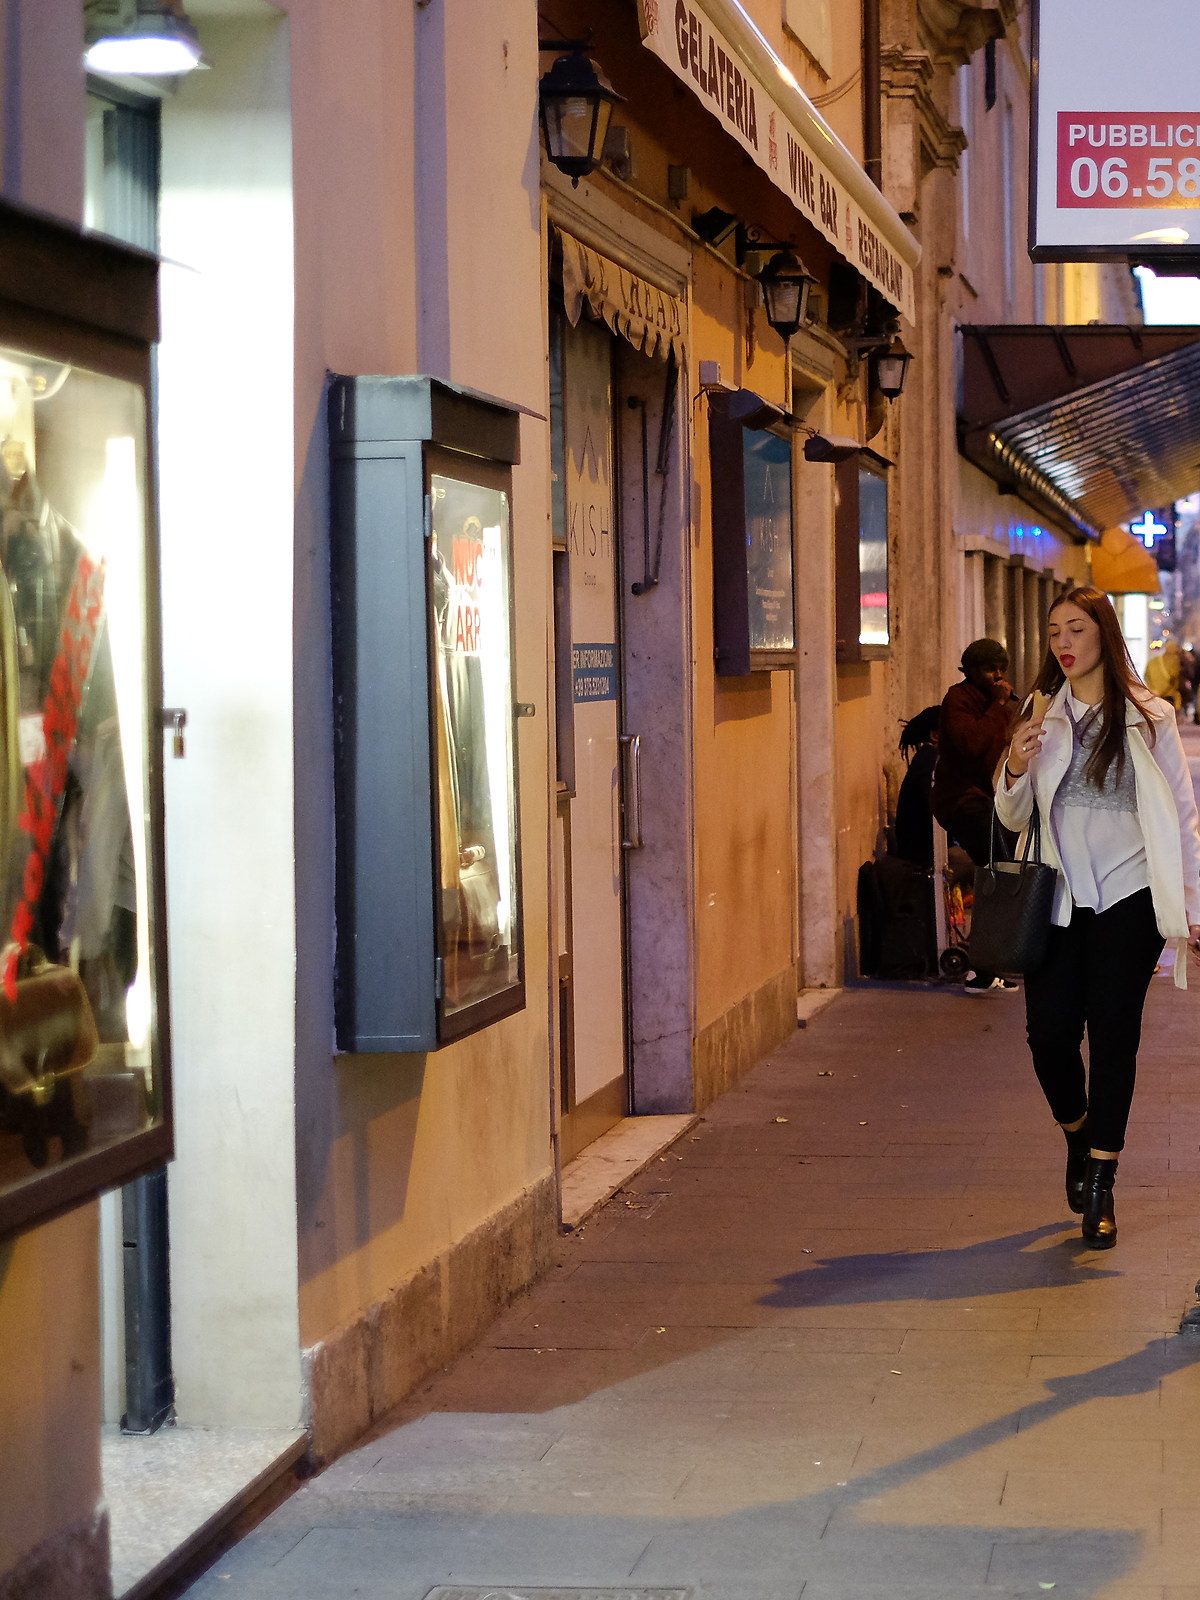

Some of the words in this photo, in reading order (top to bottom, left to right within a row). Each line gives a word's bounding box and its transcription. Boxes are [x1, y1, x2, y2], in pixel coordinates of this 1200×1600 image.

[675, 0, 759, 151] GELATERIA
[787, 132, 815, 214] WINE
[819, 173, 839, 239] BAR
[569, 502, 610, 559] KISH
